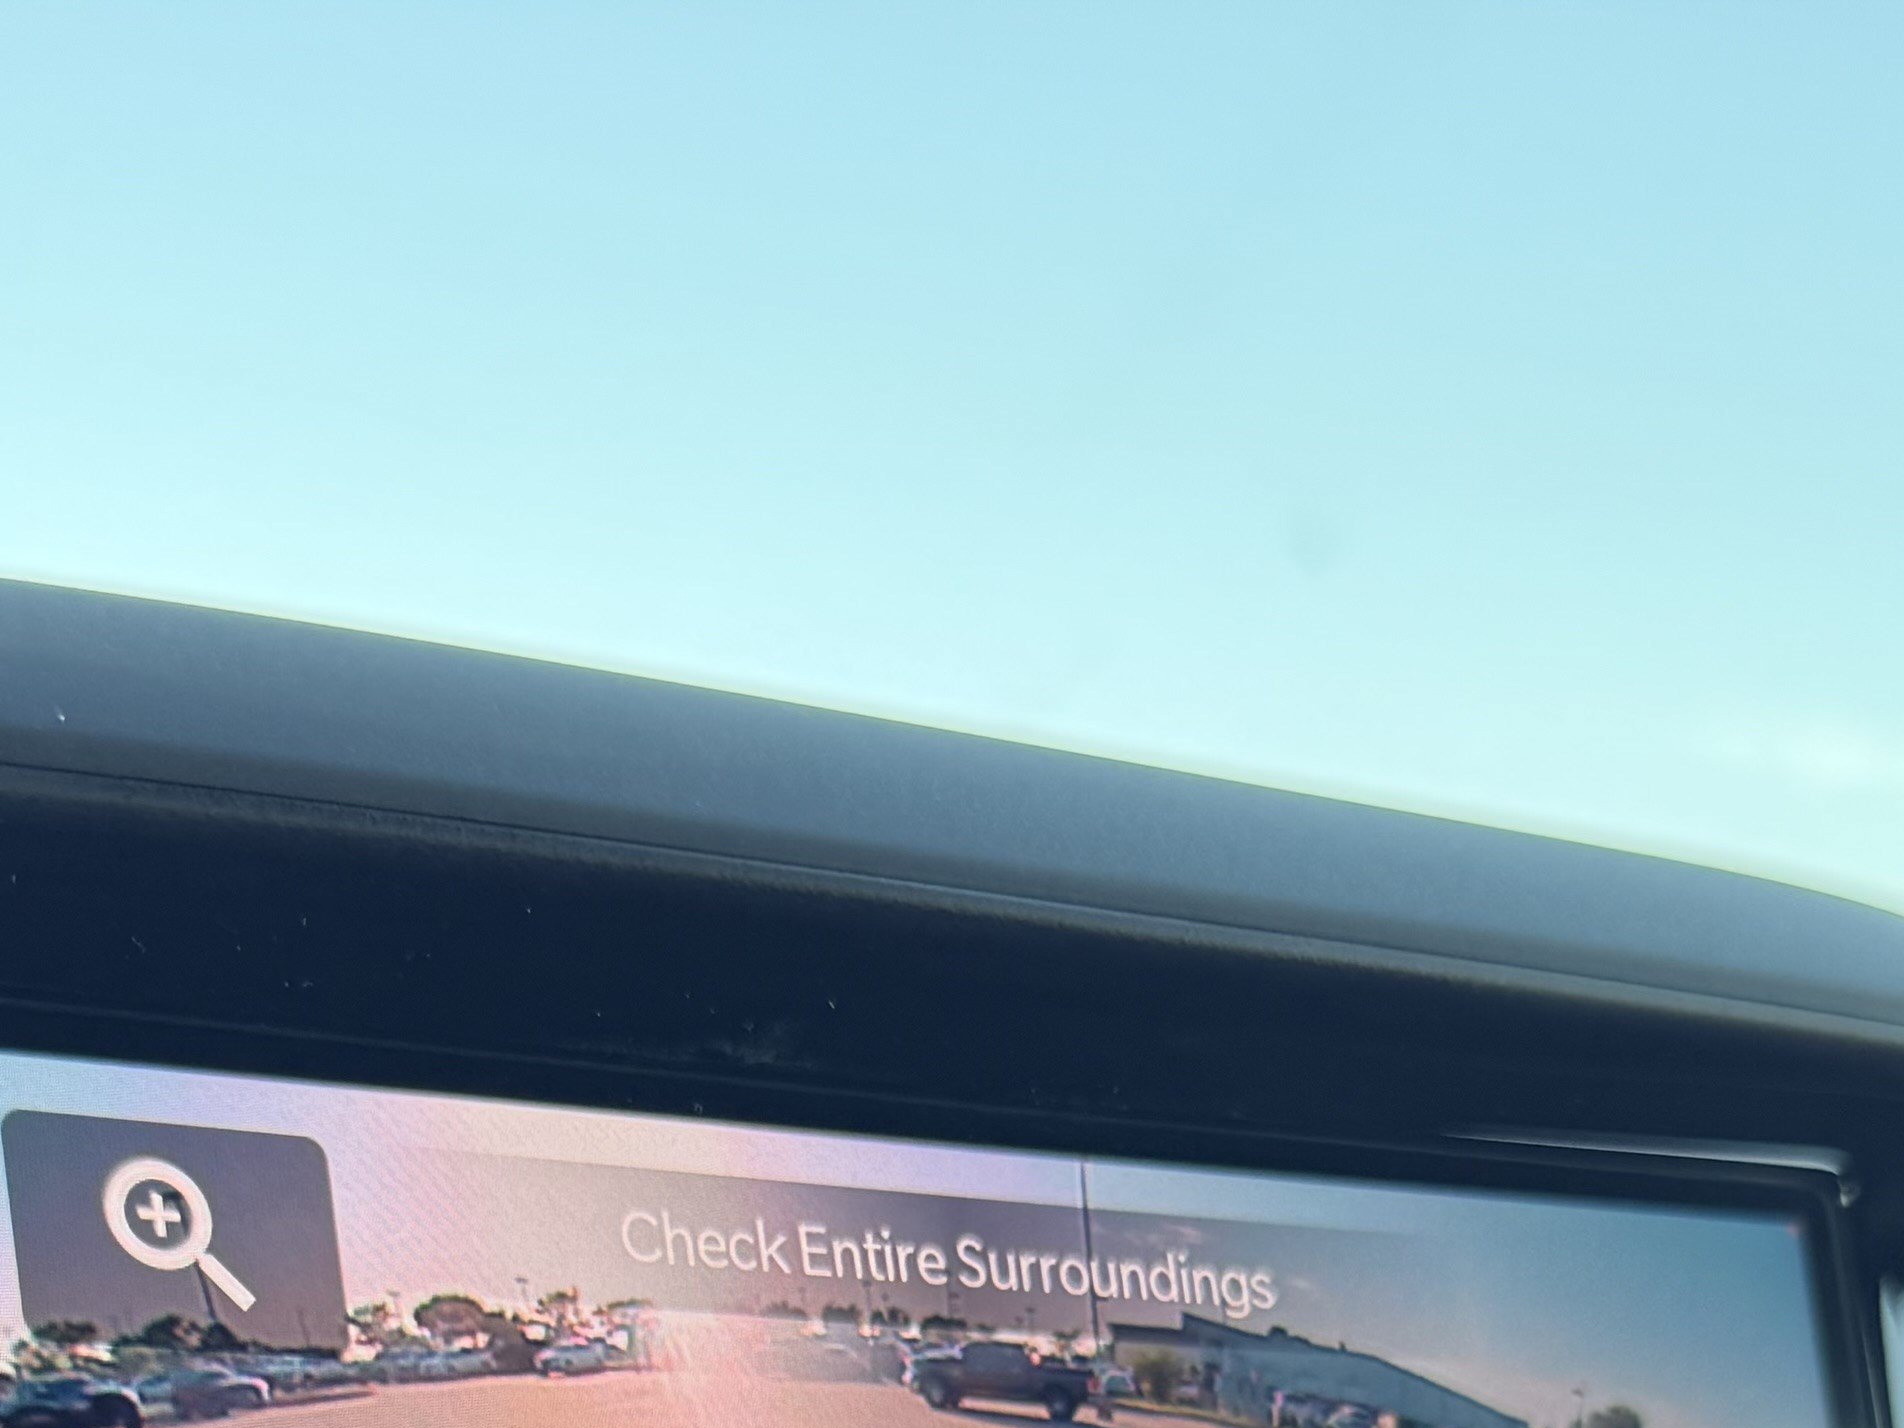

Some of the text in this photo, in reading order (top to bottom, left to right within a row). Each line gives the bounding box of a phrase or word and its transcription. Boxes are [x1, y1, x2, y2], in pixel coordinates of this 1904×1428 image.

[622, 1207, 1278, 1318] Check Entire Surroundings
